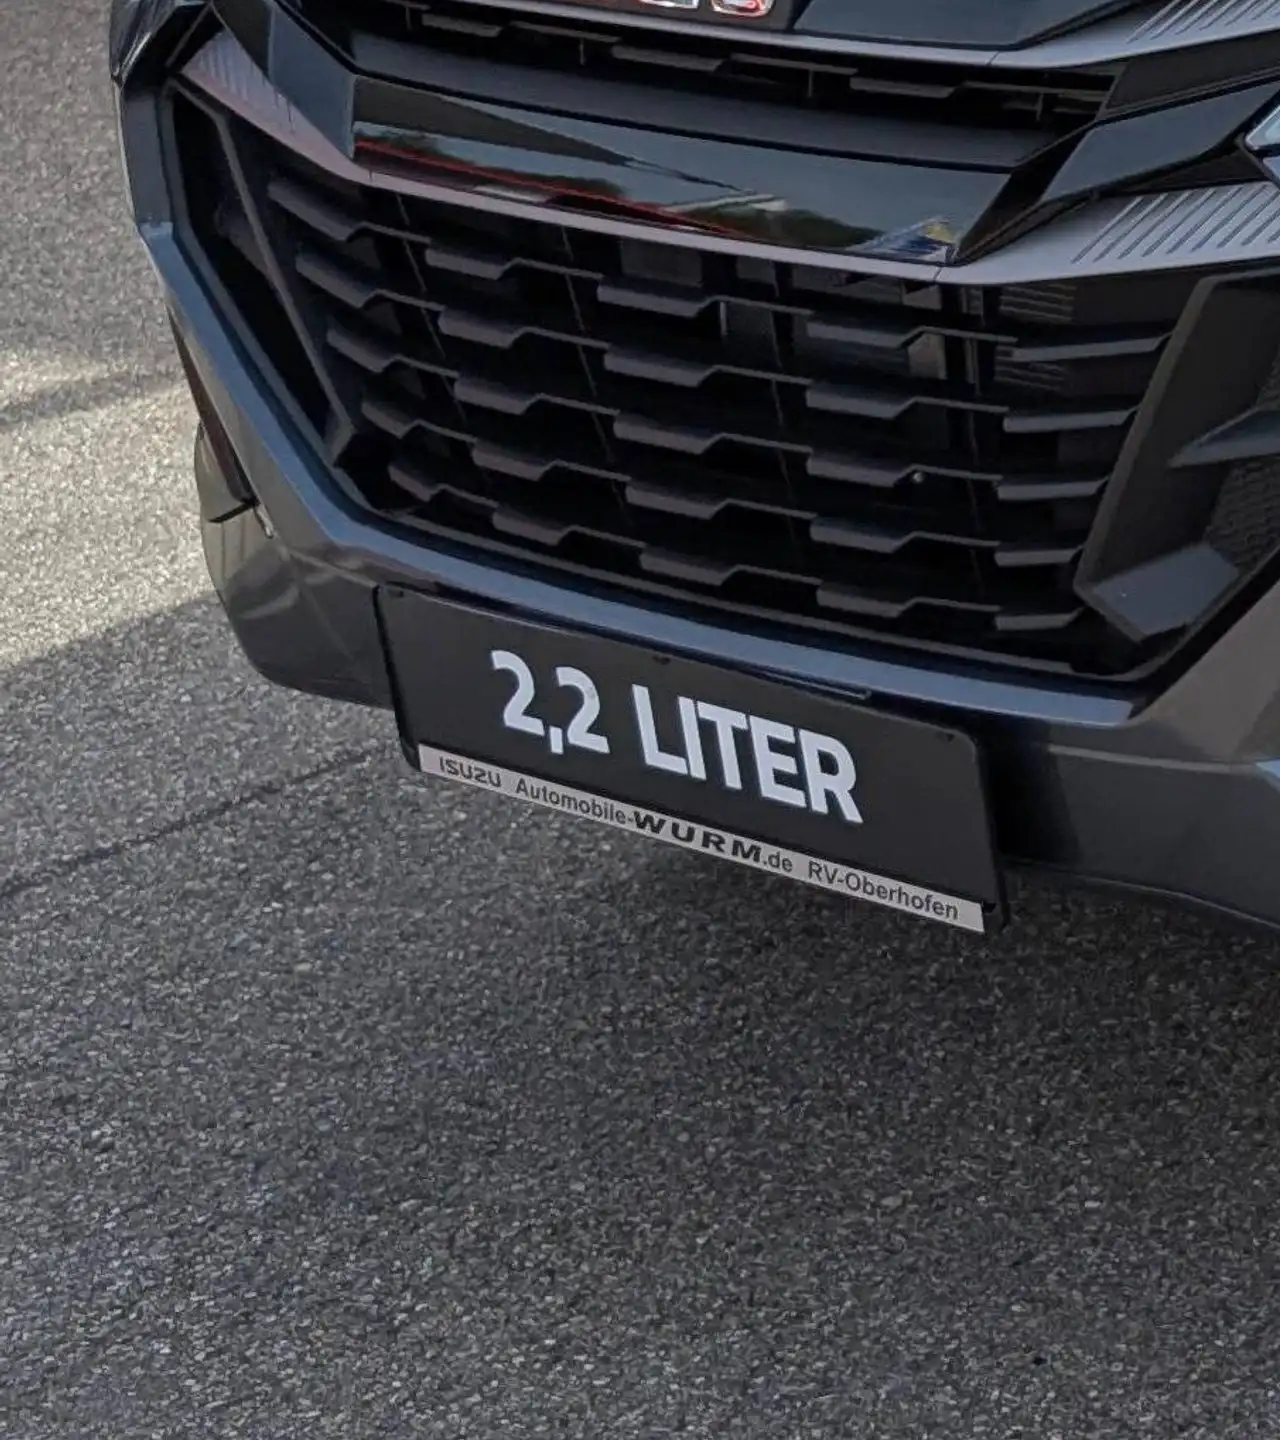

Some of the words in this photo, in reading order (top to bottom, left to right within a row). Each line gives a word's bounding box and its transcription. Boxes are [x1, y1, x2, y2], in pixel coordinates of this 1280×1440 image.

[491, 650, 610, 755] 2,2
[632, 684, 864, 823] LITER
[439, 755, 502, 788] ISUZU
[515, 777, 794, 873] Automobile-WURM.de
[807, 859, 960, 921] RV-Oberhofen
